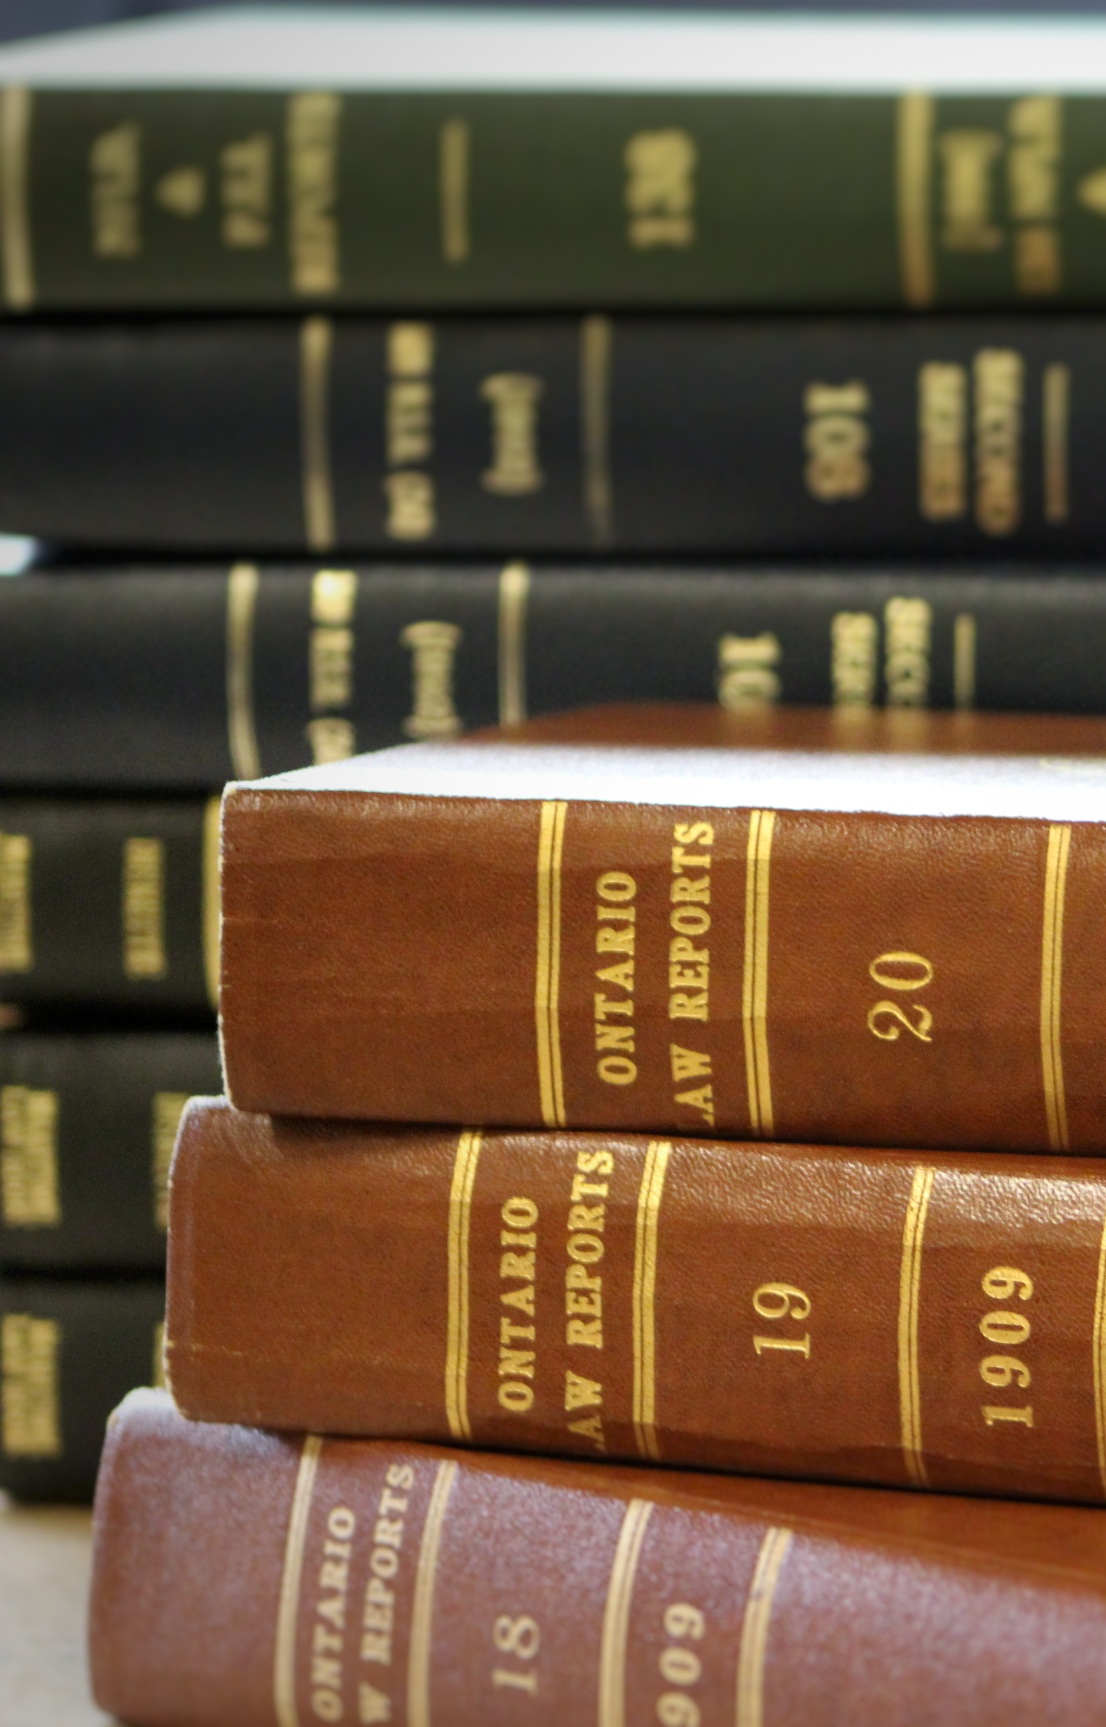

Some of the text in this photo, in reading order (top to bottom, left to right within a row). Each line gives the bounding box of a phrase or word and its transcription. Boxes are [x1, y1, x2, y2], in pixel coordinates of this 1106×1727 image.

[974, 350, 1022, 526] SECOND
[594, 872, 637, 1084] ONTARIO
[669, 820, 719, 1126] AW REPORTS
[868, 951, 933, 1041] 20
[498, 1196, 538, 1411] ONTARIO
[564, 1150, 615, 1450] AW REPORTS
[753, 1282, 811, 1358] 19
[979, 1265, 1034, 1426] 1909
[311, 1507, 356, 1722] ONTARIO
[360, 1464, 415, 1665] REPORTS
[493, 1615, 541, 1694] 18
[658, 1603, 705, 1727] 909
